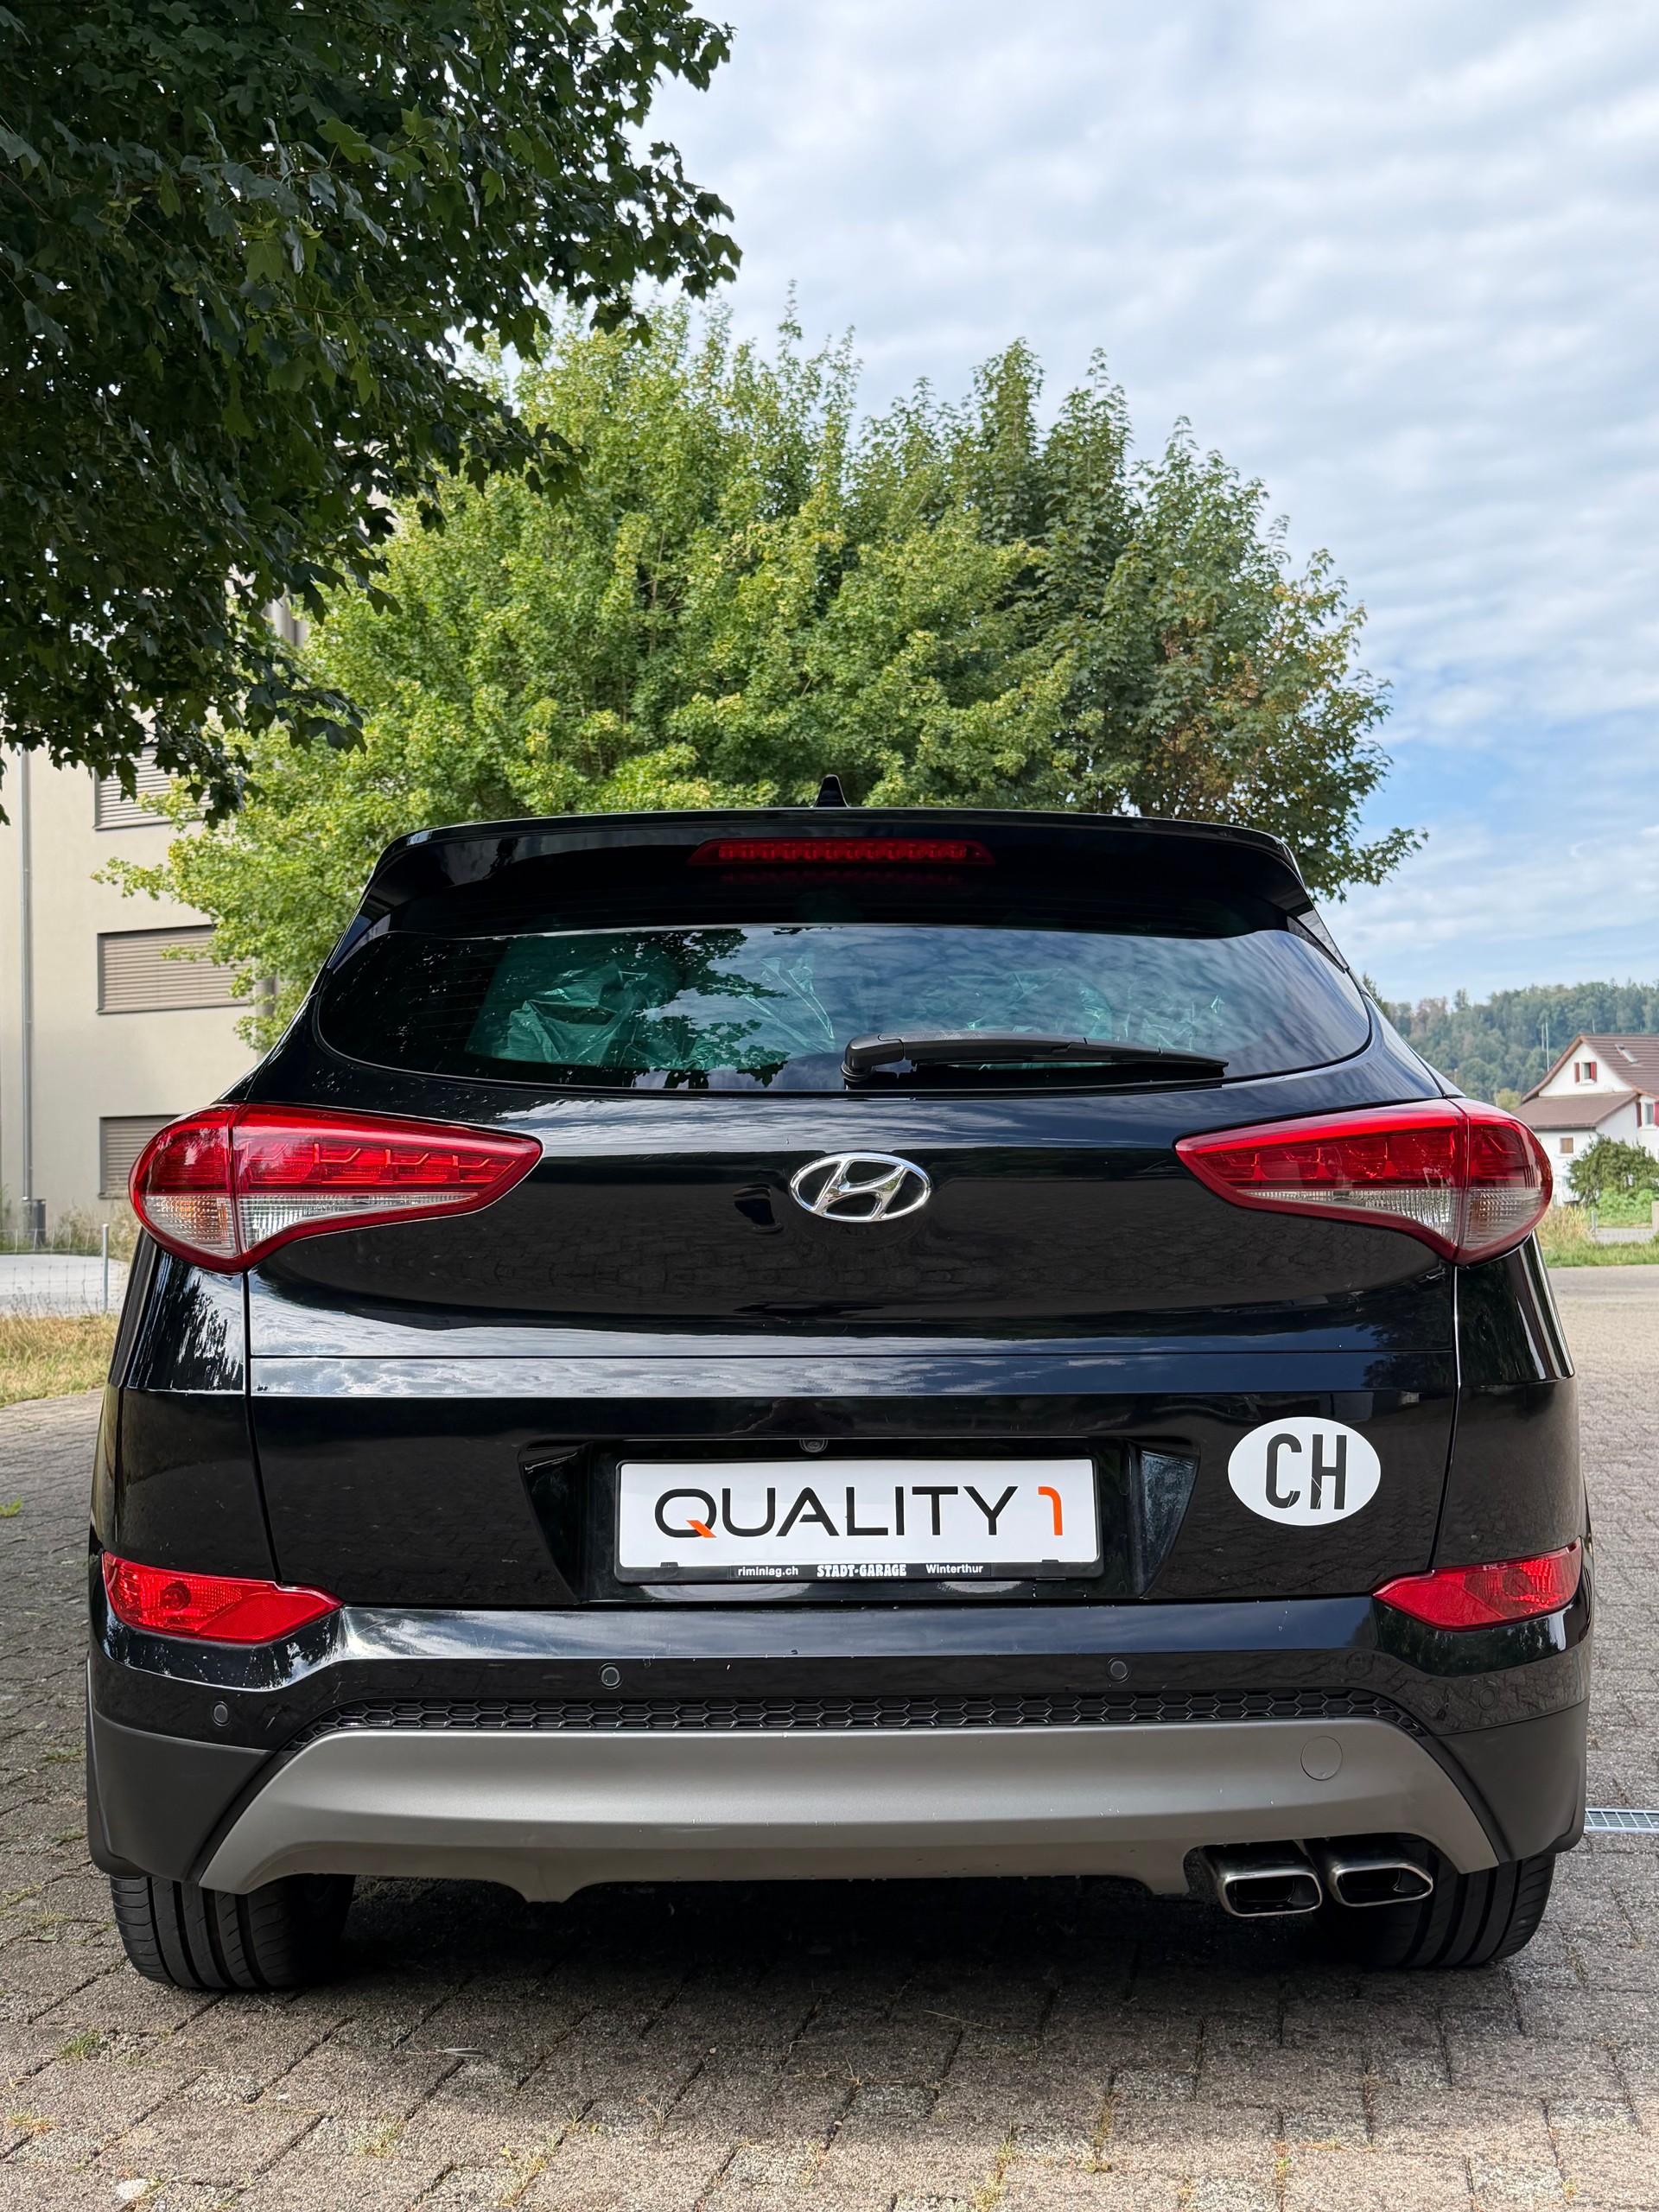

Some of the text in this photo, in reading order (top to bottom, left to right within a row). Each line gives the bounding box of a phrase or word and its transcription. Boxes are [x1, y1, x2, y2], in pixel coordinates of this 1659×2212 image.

[1266, 1433, 1347, 1510] CH
[654, 1485, 1063, 1538] QUALITY 1
[925, 1563, 983, 1574] Winterthur
